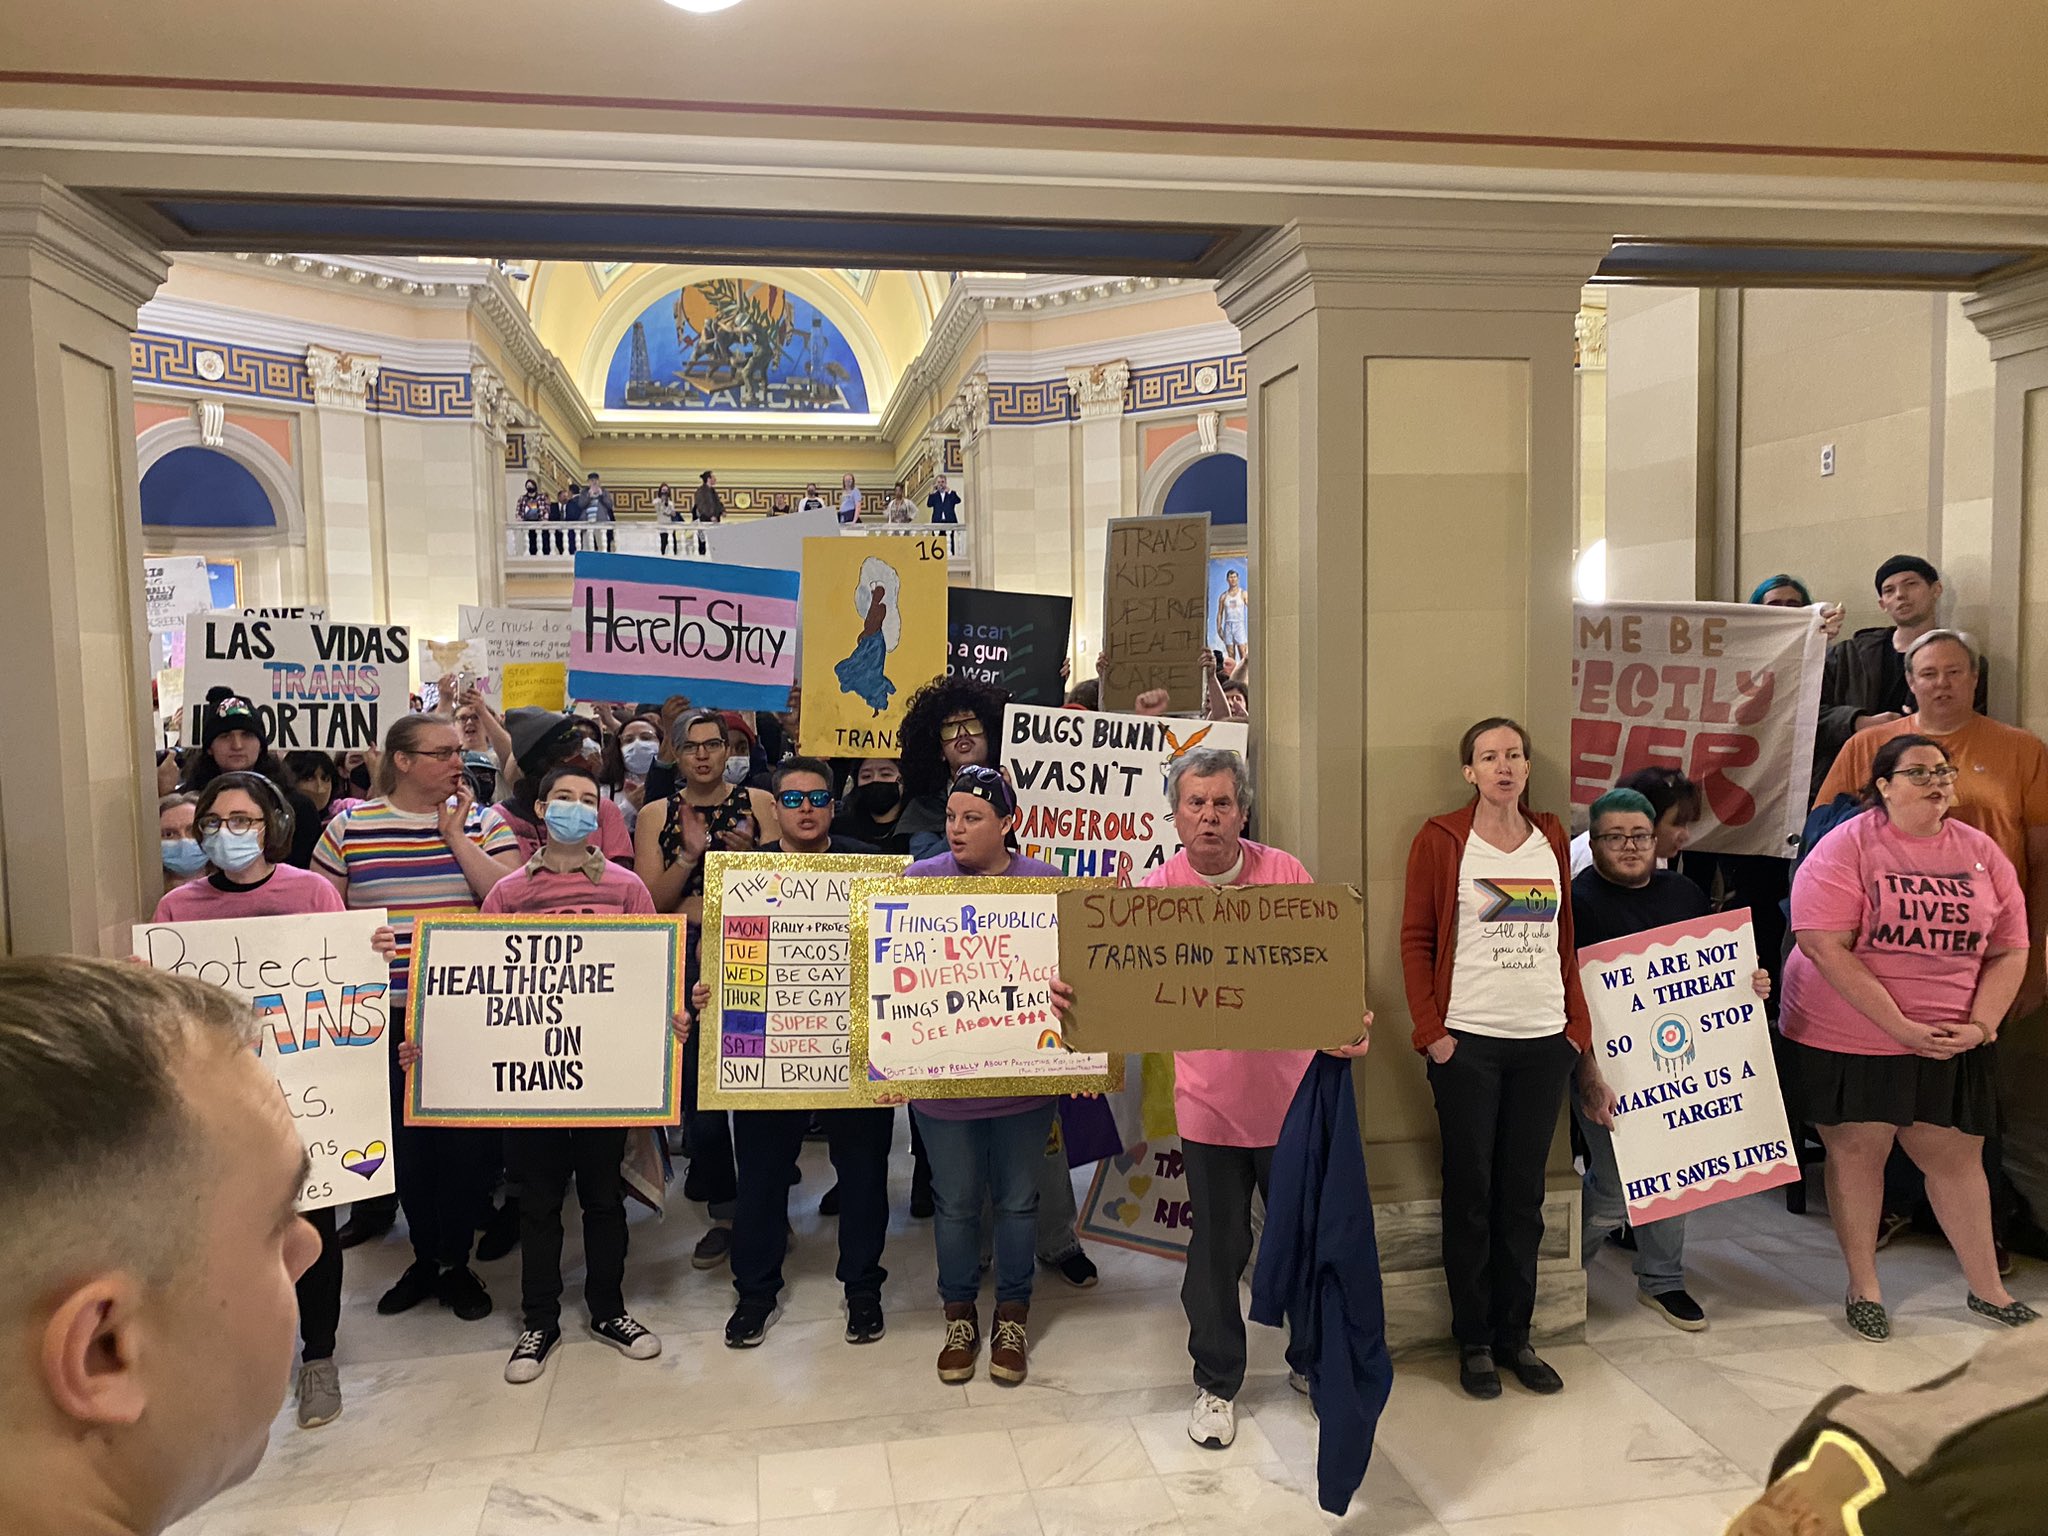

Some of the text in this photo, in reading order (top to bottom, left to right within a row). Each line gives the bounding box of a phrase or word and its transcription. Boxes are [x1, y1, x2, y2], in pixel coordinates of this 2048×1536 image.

[915, 540, 944, 561] 16
[1112, 524, 1199, 557] TRANS
[1115, 562, 1175, 590] KIDS
[466, 609, 495, 634] We
[501, 620, 534, 633] must
[963, 623, 974, 637] a
[976, 625, 1007, 640] car
[1580, 615, 1727, 657] ME BE
[205, 621, 410, 664] LAS VIDAS
[957, 643, 969, 657] a
[974, 644, 1007, 664] gun
[263, 662, 380, 702] TRANS
[962, 665, 1000, 684] war
[1107, 660, 1191, 691] CARE
[1010, 712, 1170, 752] BUGS BUNNY
[1010, 758, 1143, 797] WASN'T
[729, 873, 768, 903] THE
[780, 877, 819, 901] GAY
[1884, 874, 1975, 899] TRANS
[874, 902, 959, 933] THINGS
[1083, 894, 1338, 929] SUPPORT AND DEFEND
[1899, 899, 1970, 924] LIVES
[728, 920, 763, 937] MON
[772, 921, 805, 935] RALLY
[1481, 923, 1551, 946] All of who
[1877, 923, 1982, 951] MATTER
[505, 935, 583, 964] STOP
[726, 943, 849, 961] TUE TACOS!
[1087, 943, 1329, 970] TRANS AND INTERSEX
[1492, 944, 1544, 961] you are is
[1501, 955, 1537, 970] sacred
[427, 963, 615, 996] HEALTHCARE
[725, 967, 846, 983] WED BE GAY
[1601, 941, 1739, 991] WE ARE NOT
[724, 989, 847, 1007] THUR BE GAY
[871, 994, 939, 1020] THINGS
[946, 989, 1000, 1015] DRAG
[1155, 982, 1245, 1010] LIVES
[1631, 969, 1737, 1012] A THREAT
[250, 983, 388, 1058] ANS
[486, 995, 564, 1026] BANS
[771, 1014, 827, 1032] SUPER
[544, 1026, 582, 1057] ON
[912, 1014, 1015, 1045] SEE ABOVE
[1606, 1003, 1754, 1058] SO STOP
[723, 1035, 760, 1055] SAT
[770, 1038, 822, 1054] SUPER
[492, 1060, 584, 1092] TRANS
[724, 1061, 760, 1083] SUN
[928, 1065, 945, 1074] NOT
[949, 1062, 979, 1073] REALLY
[984, 1059, 1008, 1068] ABOUT
[1612, 1060, 1756, 1117] MAKING US A
[1663, 1093, 1744, 1130] TARGET
[1626, 1140, 1789, 1201] HRT SAVES LIVES
